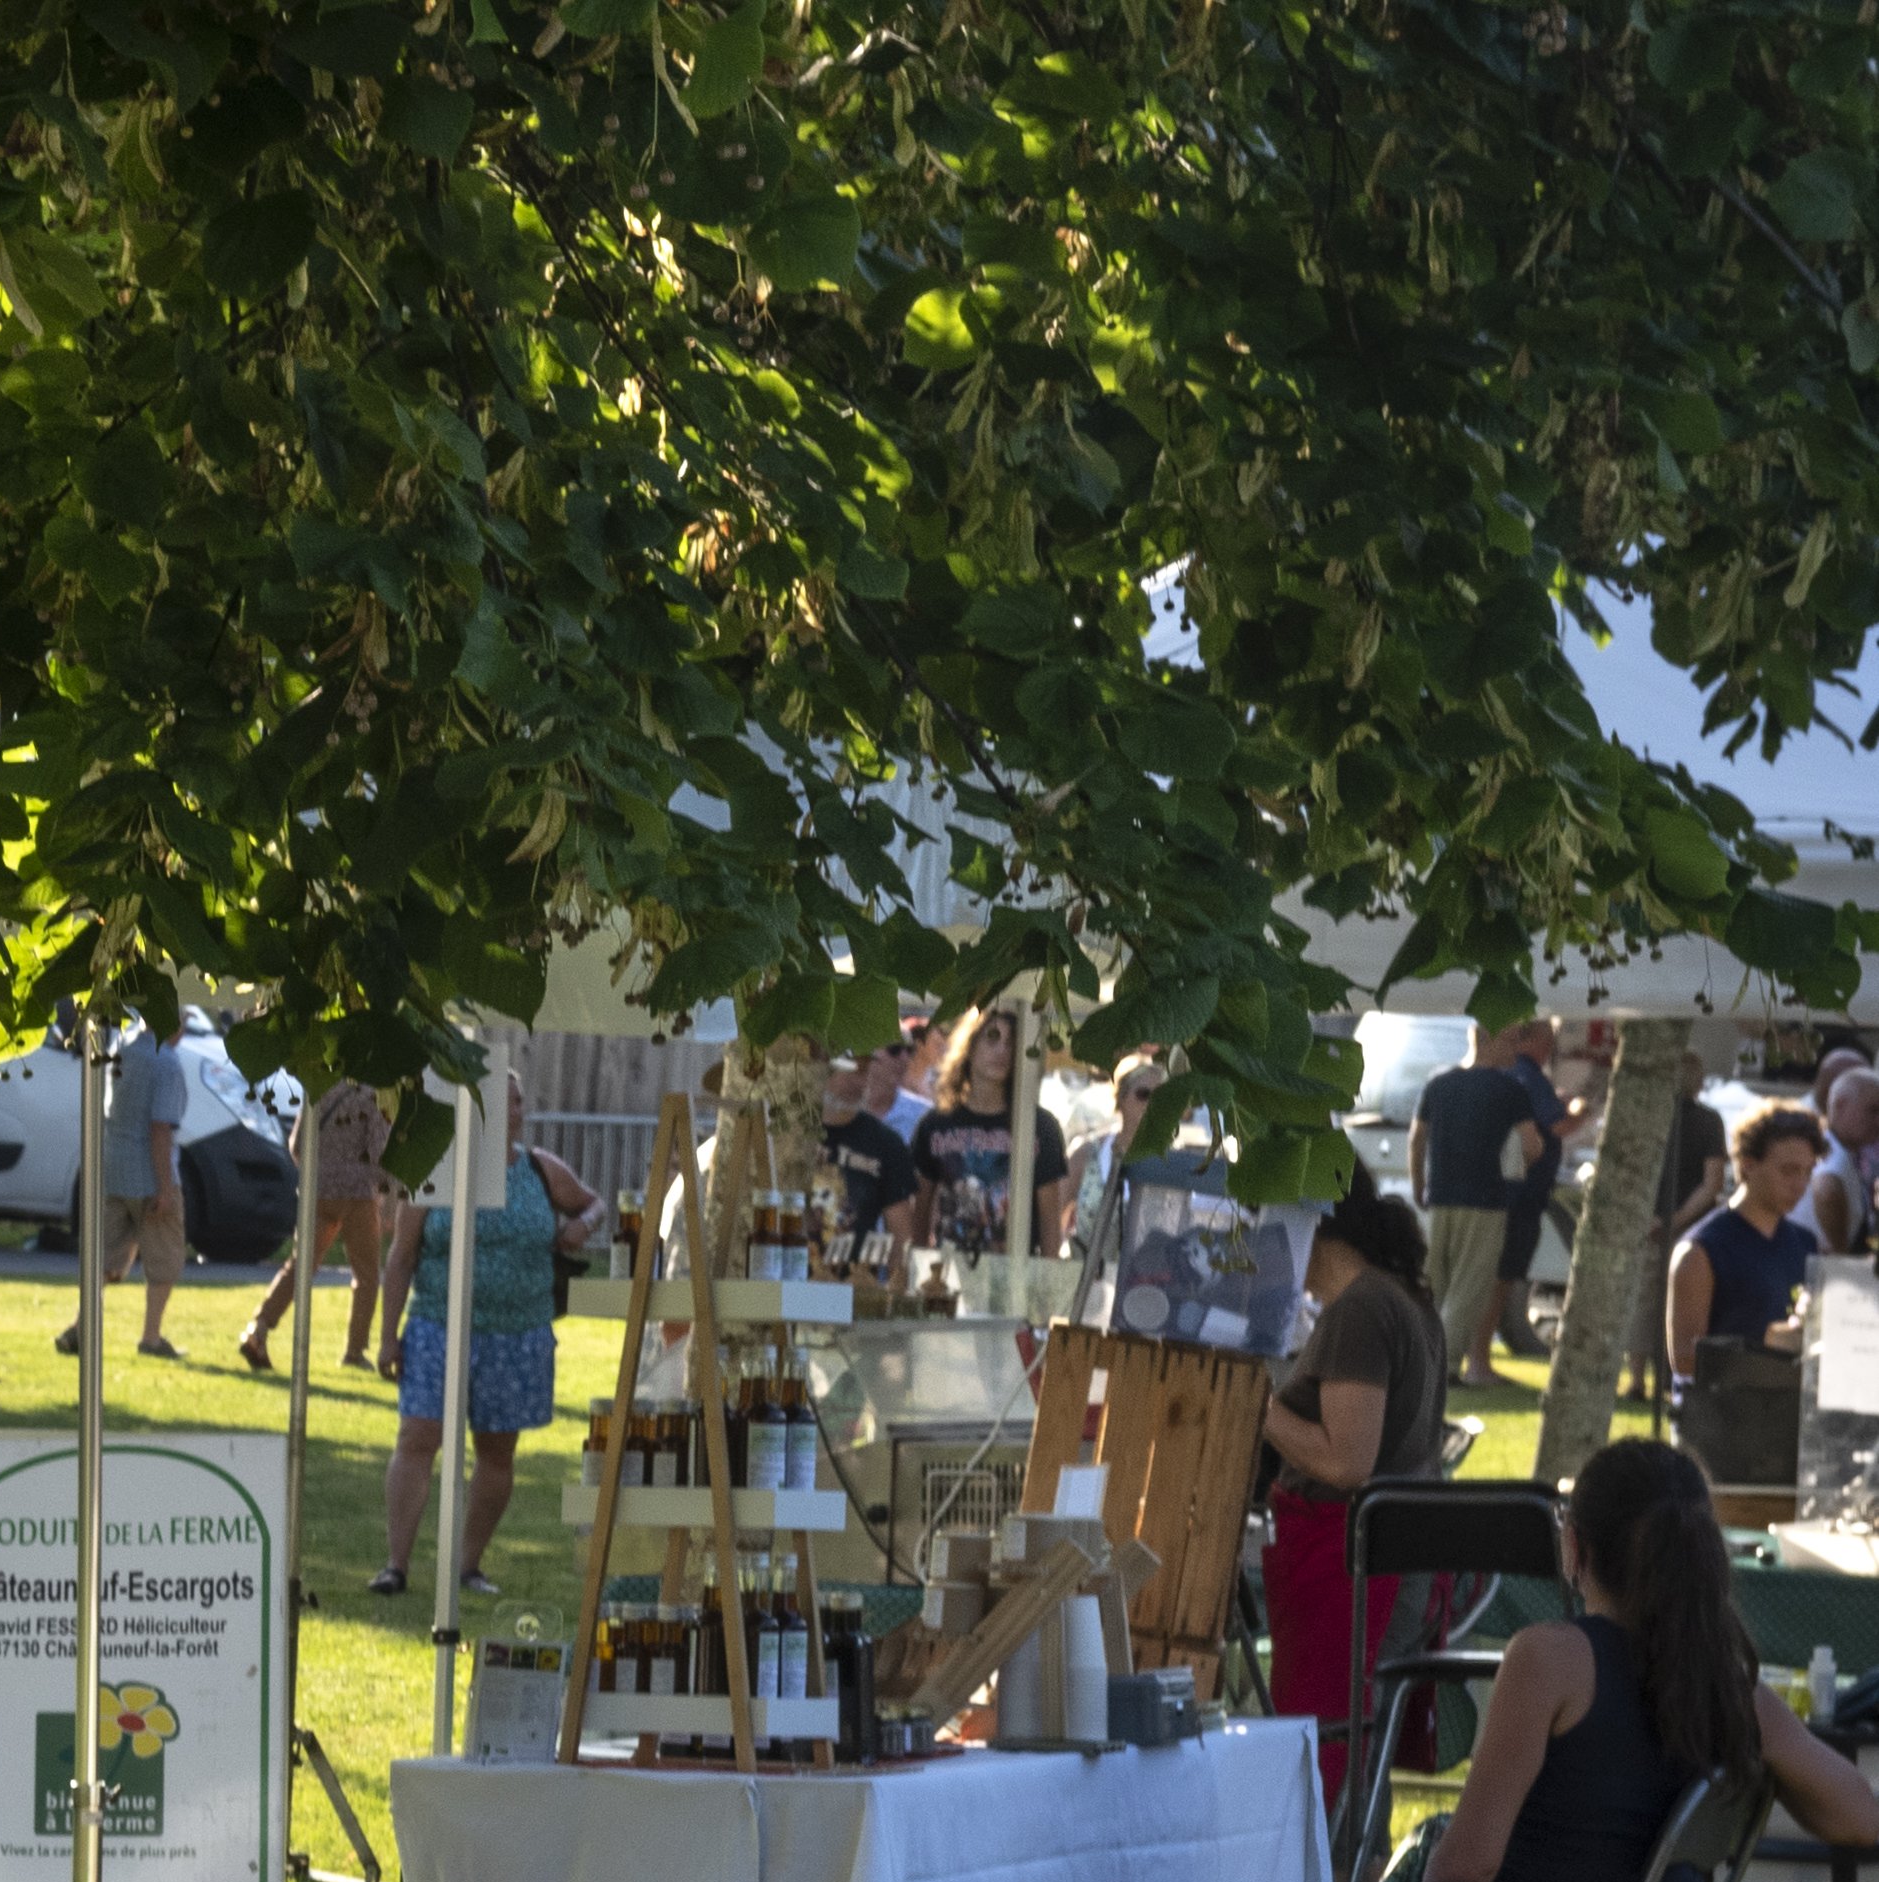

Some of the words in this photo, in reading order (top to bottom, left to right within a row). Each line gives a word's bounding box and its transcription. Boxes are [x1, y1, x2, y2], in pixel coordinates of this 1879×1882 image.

[105, 1523, 131, 1545] DE
[138, 1522, 163, 1545] LA
[169, 1516, 257, 1545] FERME
[123, 1615, 226, 1635] Héliciculteur
[45, 1810, 56, 1831] à
[102, 1815, 156, 1832] erme
[0, 1844, 33, 1857] Vivez
[38, 1844, 50, 1857] la
[121, 1844, 135, 1857] de
[139, 1844, 165, 1860] plus
